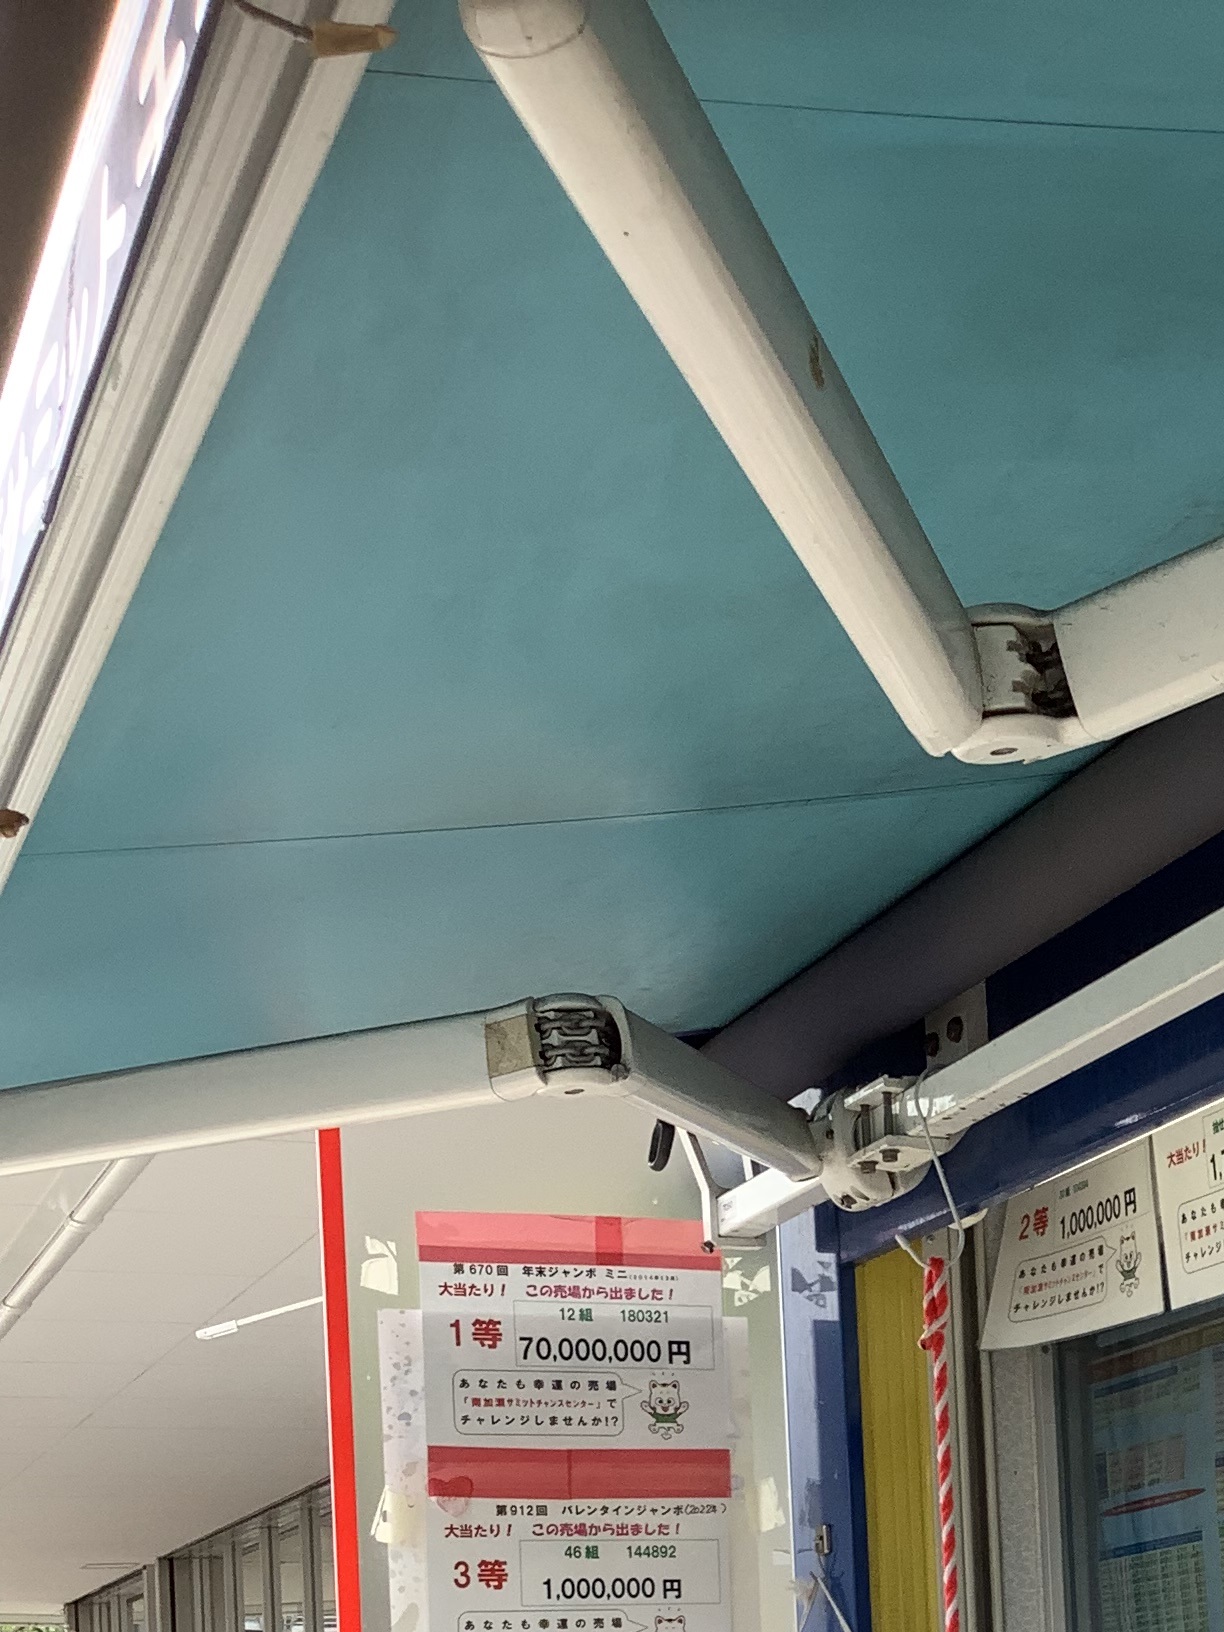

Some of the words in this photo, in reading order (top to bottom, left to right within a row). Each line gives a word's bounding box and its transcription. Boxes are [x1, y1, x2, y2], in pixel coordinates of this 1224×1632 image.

[1018, 1206, 1048, 1241] 2等
[1060, 1187, 1136, 1239] 1,000,000円
[453, 1263, 508, 1278] 第670回
[522, 1265, 596, 1279] 年末ジャンボ
[439, 1282, 506, 1298] 大当たり！
[526, 1284, 674, 1301] この売場から出ました！
[559, 1308, 593, 1323] 12組
[620, 1309, 669, 1324] 180321
[449, 1318, 502, 1349] 1等
[519, 1336, 691, 1365] 70,000,000円
[459, 1378, 617, 1392] あなたも幸運の売場
[460, 1414, 619, 1428] チャレンジしませんか!?
[496, 1504, 548, 1517] 第912回
[445, 1523, 511, 1539] 大当たり！
[532, 1522, 680, 1537] この売場から出ました！
[564, 1546, 599, 1559] 46組
[626, 1545, 677, 1559] 144892
[453, 1559, 509, 1590] 3等
[543, 1577, 682, 1601] 1,000,000円
[464, 1617, 622, 1631] あなたも幸運の売場
